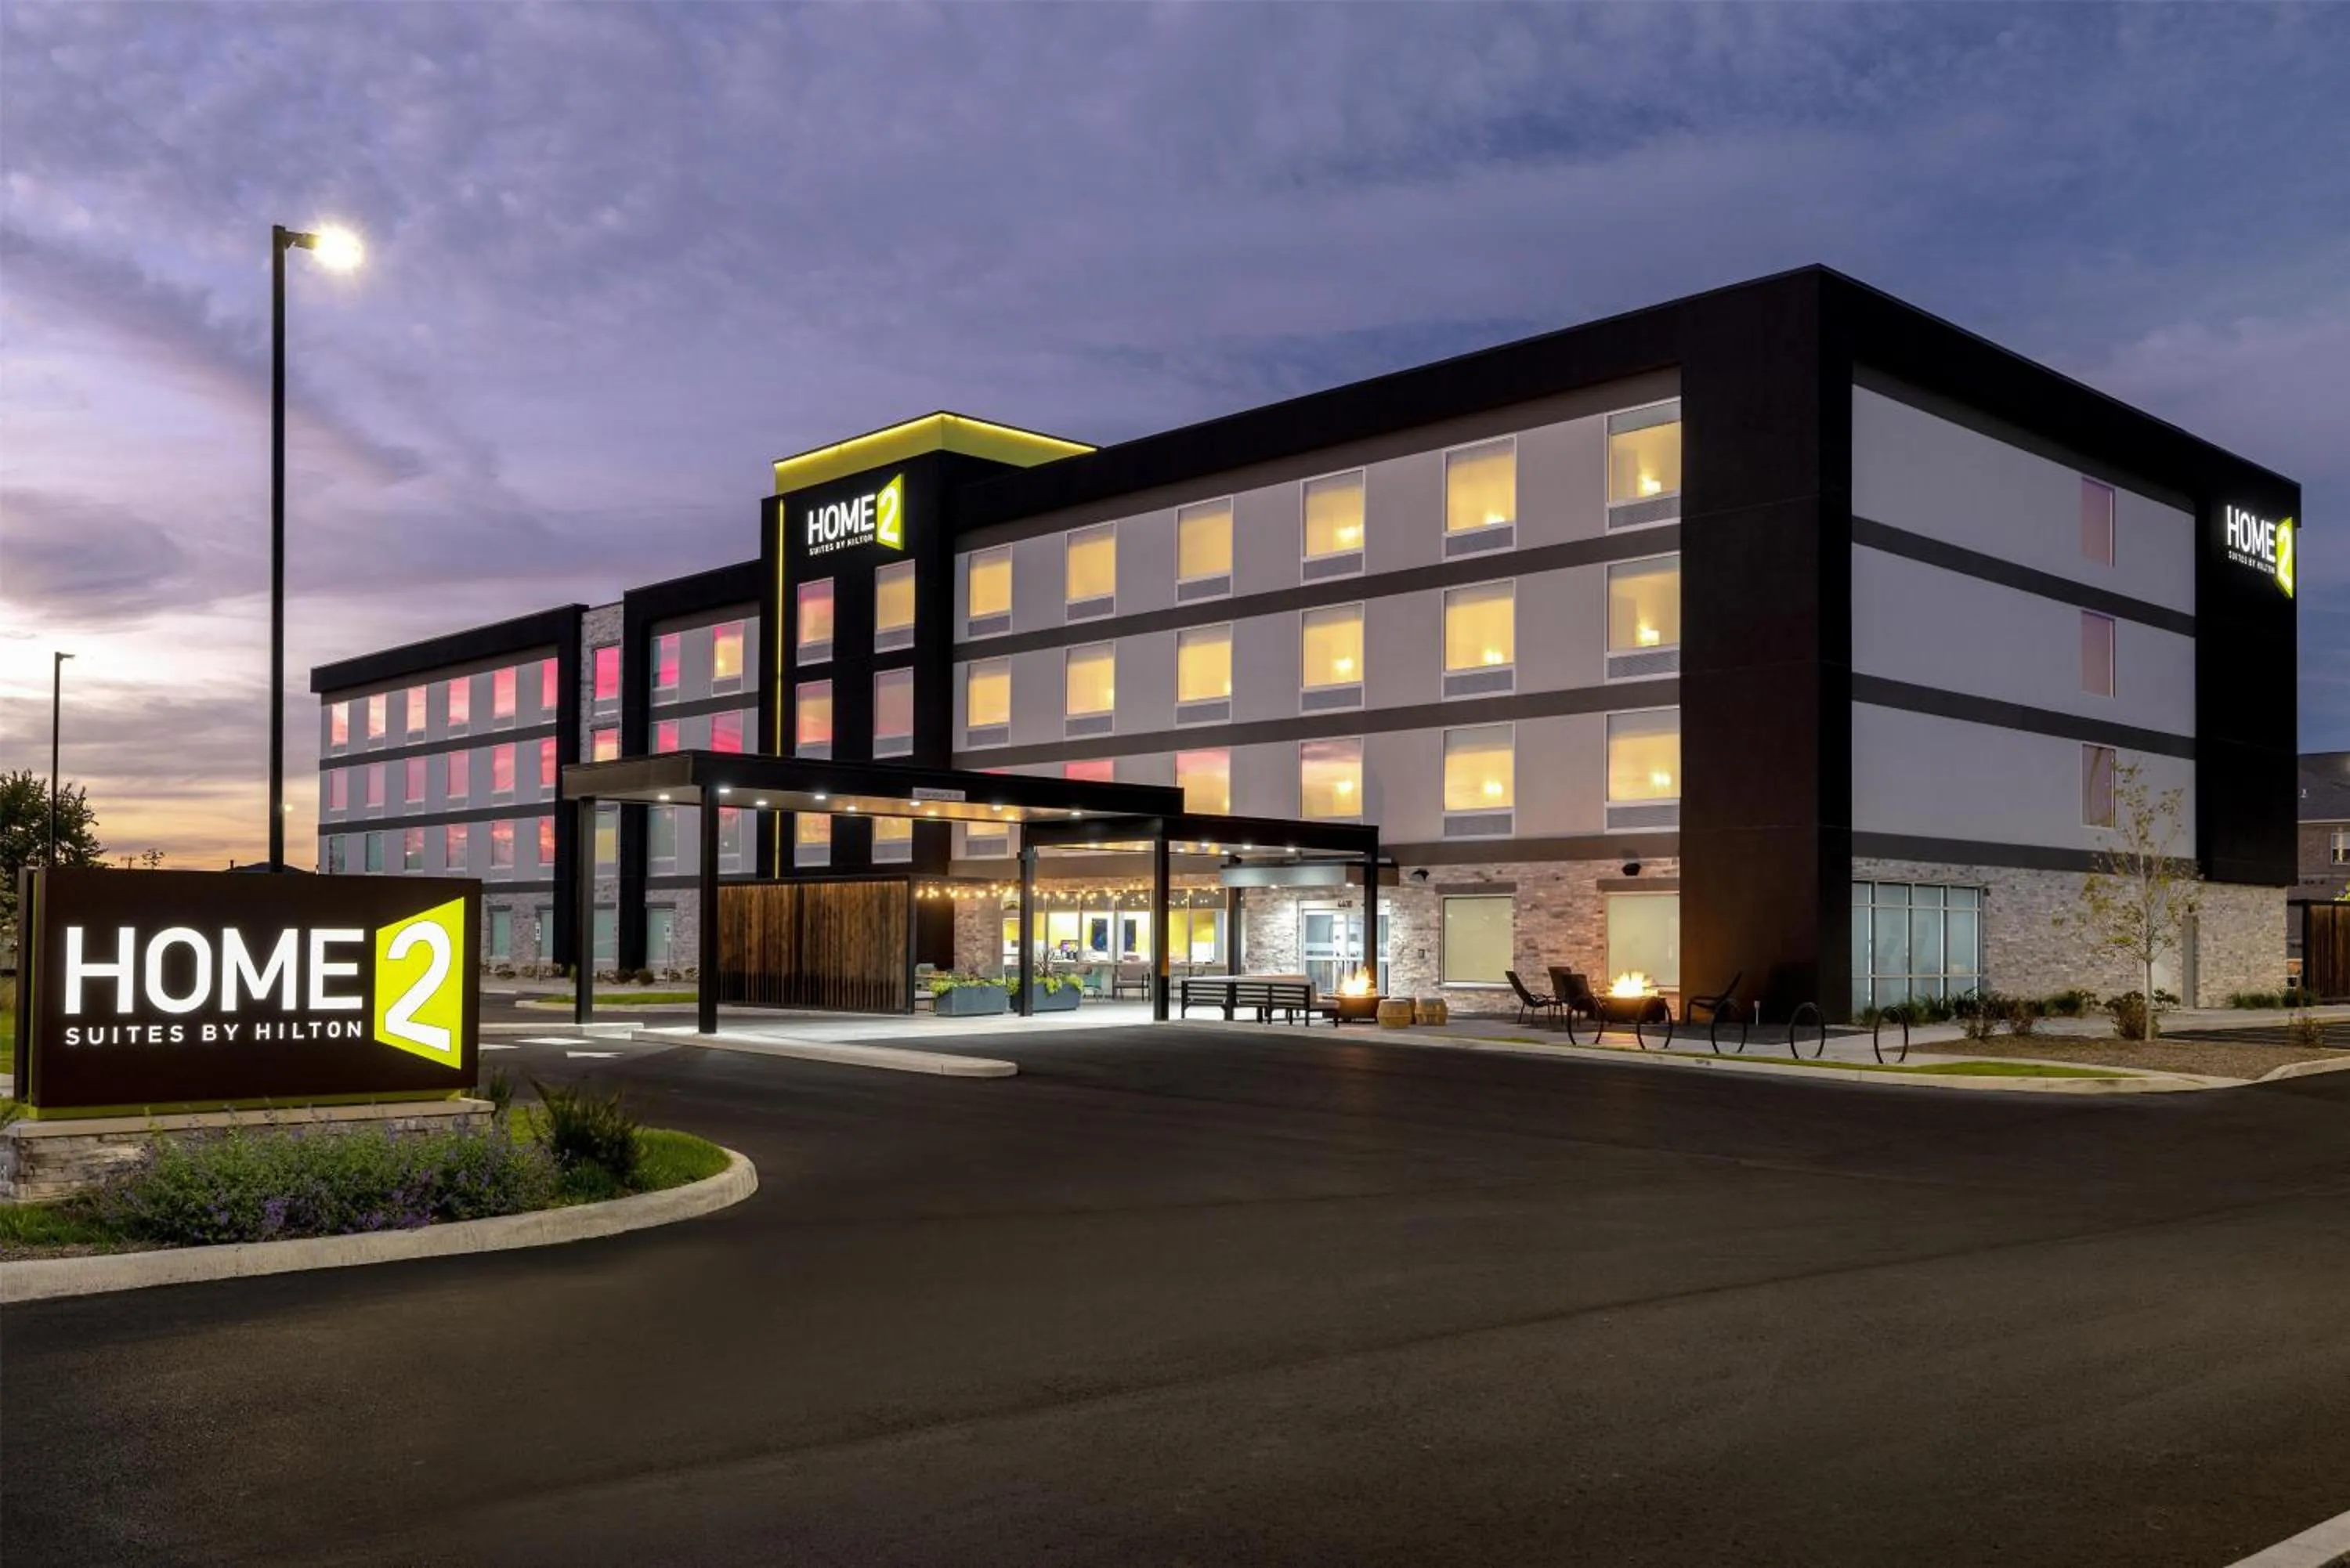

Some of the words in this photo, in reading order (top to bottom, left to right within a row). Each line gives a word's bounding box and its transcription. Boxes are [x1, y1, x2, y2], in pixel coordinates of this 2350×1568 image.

[65, 1024, 184, 1046] SUITES
[201, 1024, 239, 1042] BY
[255, 1021, 362, 1041] HILTON
